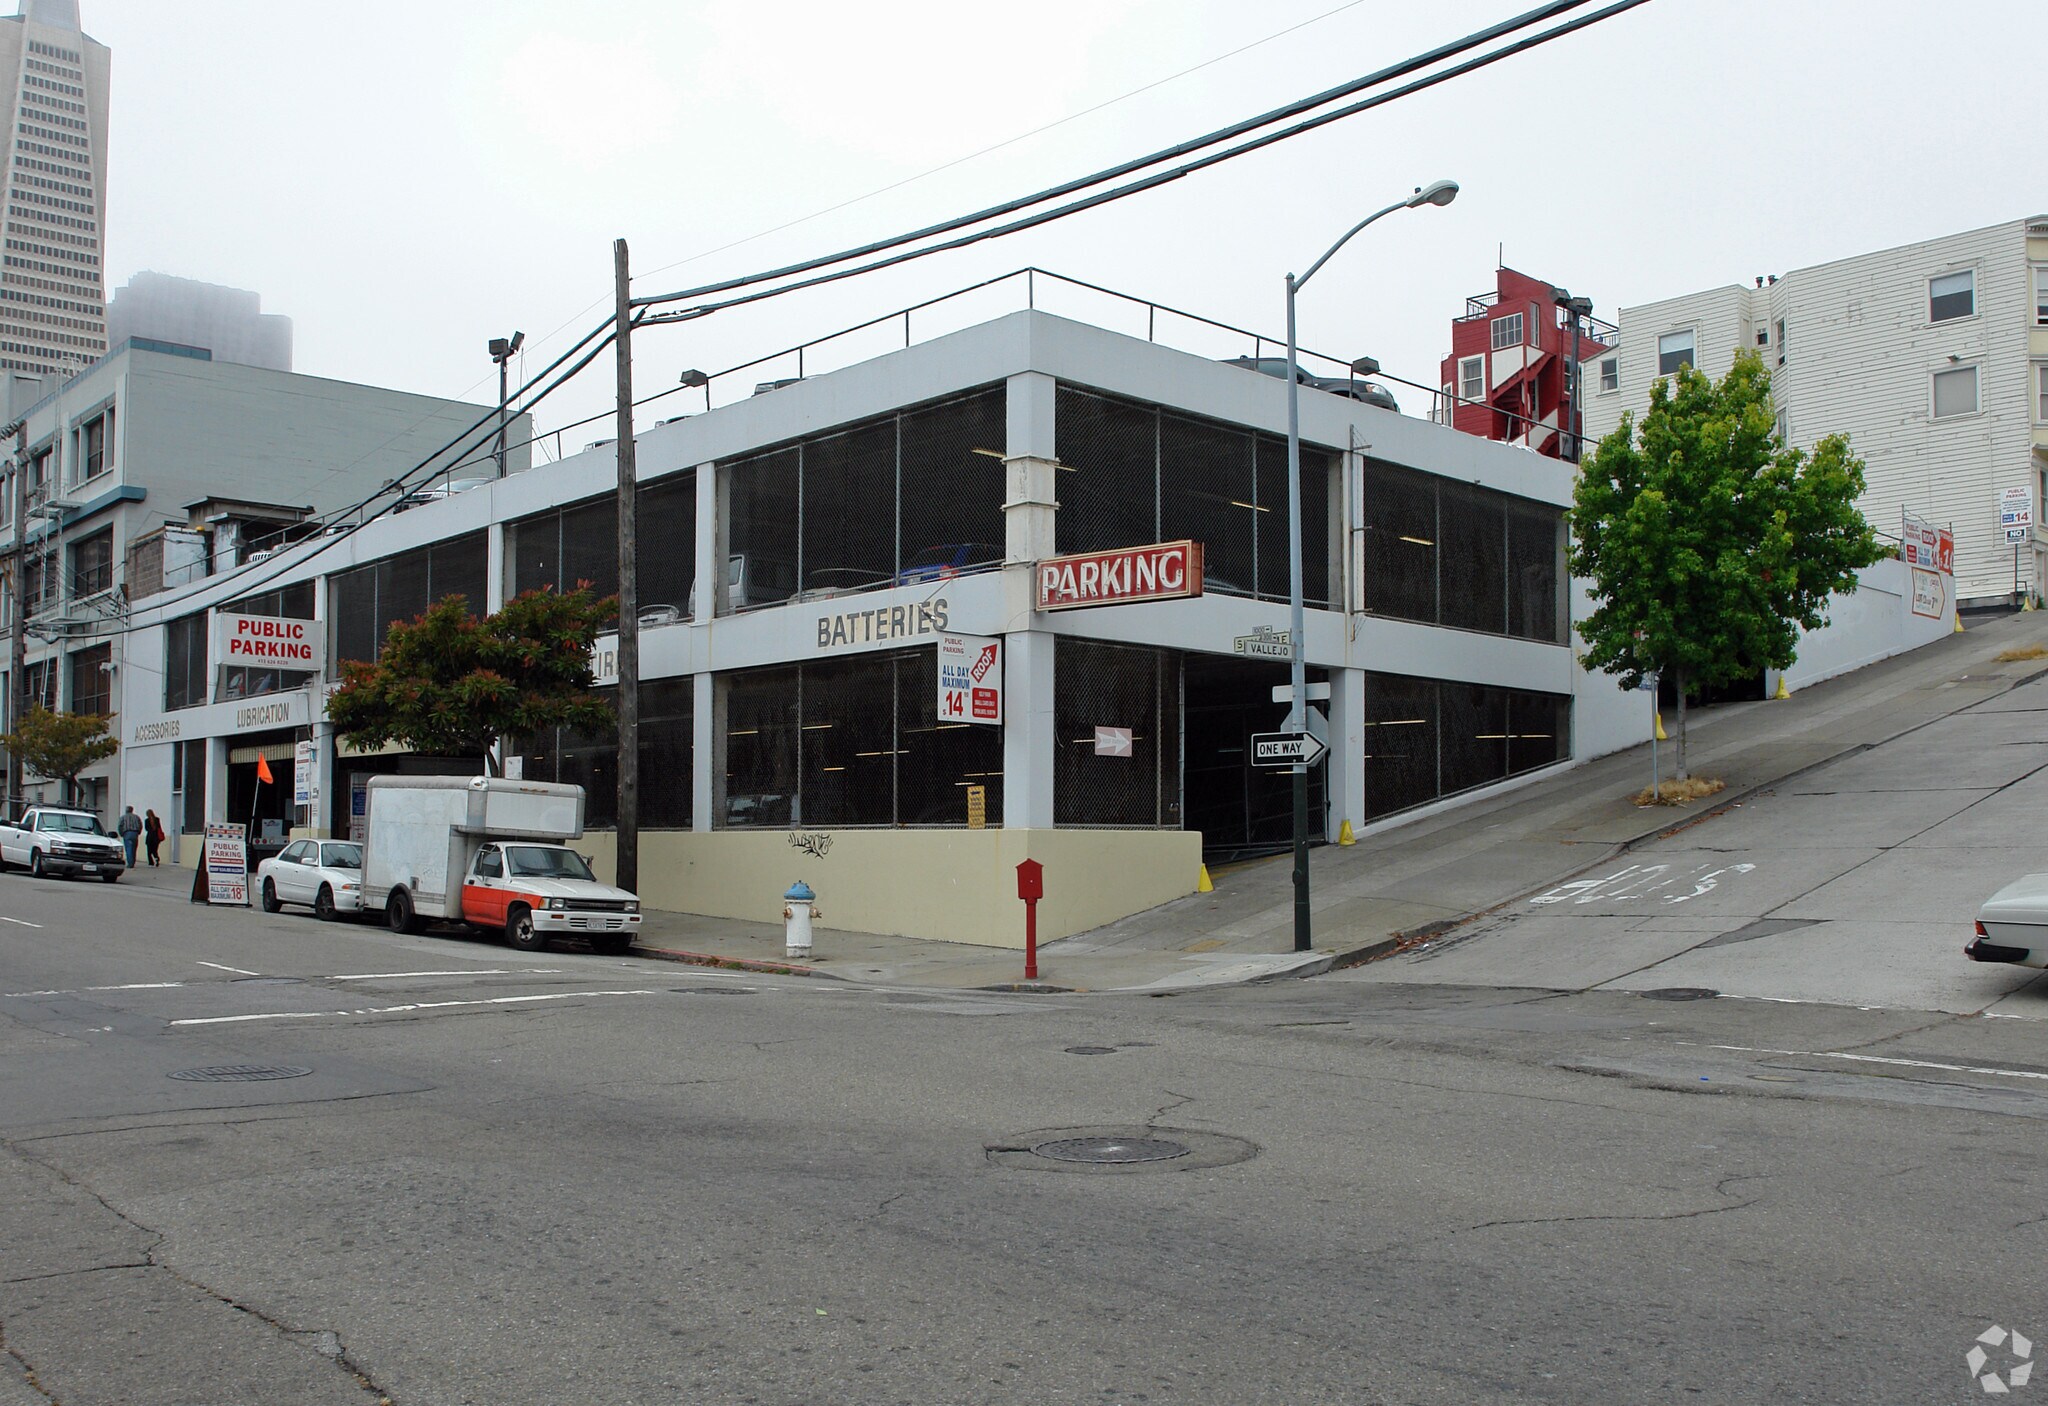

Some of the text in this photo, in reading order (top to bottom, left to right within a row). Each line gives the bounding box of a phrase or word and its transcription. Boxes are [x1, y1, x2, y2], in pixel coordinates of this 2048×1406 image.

[1041, 551, 1183, 602] PARKING
[238, 619, 304, 639] PUBLIC
[818, 599, 949, 647] BATTERIES
[945, 638, 962, 646] PUBLIC
[230, 639, 312, 660] PARKING
[943, 646, 964, 654] PARKING
[1251, 644, 1289, 656] VALLEJO
[943, 665, 970, 678] ALL DAY
[973, 649, 993, 680] ROOF
[942, 676, 970, 690] MAXIMUM
[237, 702, 290, 728] LUBRICATION
[135, 719, 180, 742] ACCESSORIES
[1260, 742, 1302, 755] ONE WAY
[213, 842, 239, 851] PUBLIC
[211, 850, 242, 858] PARKING
